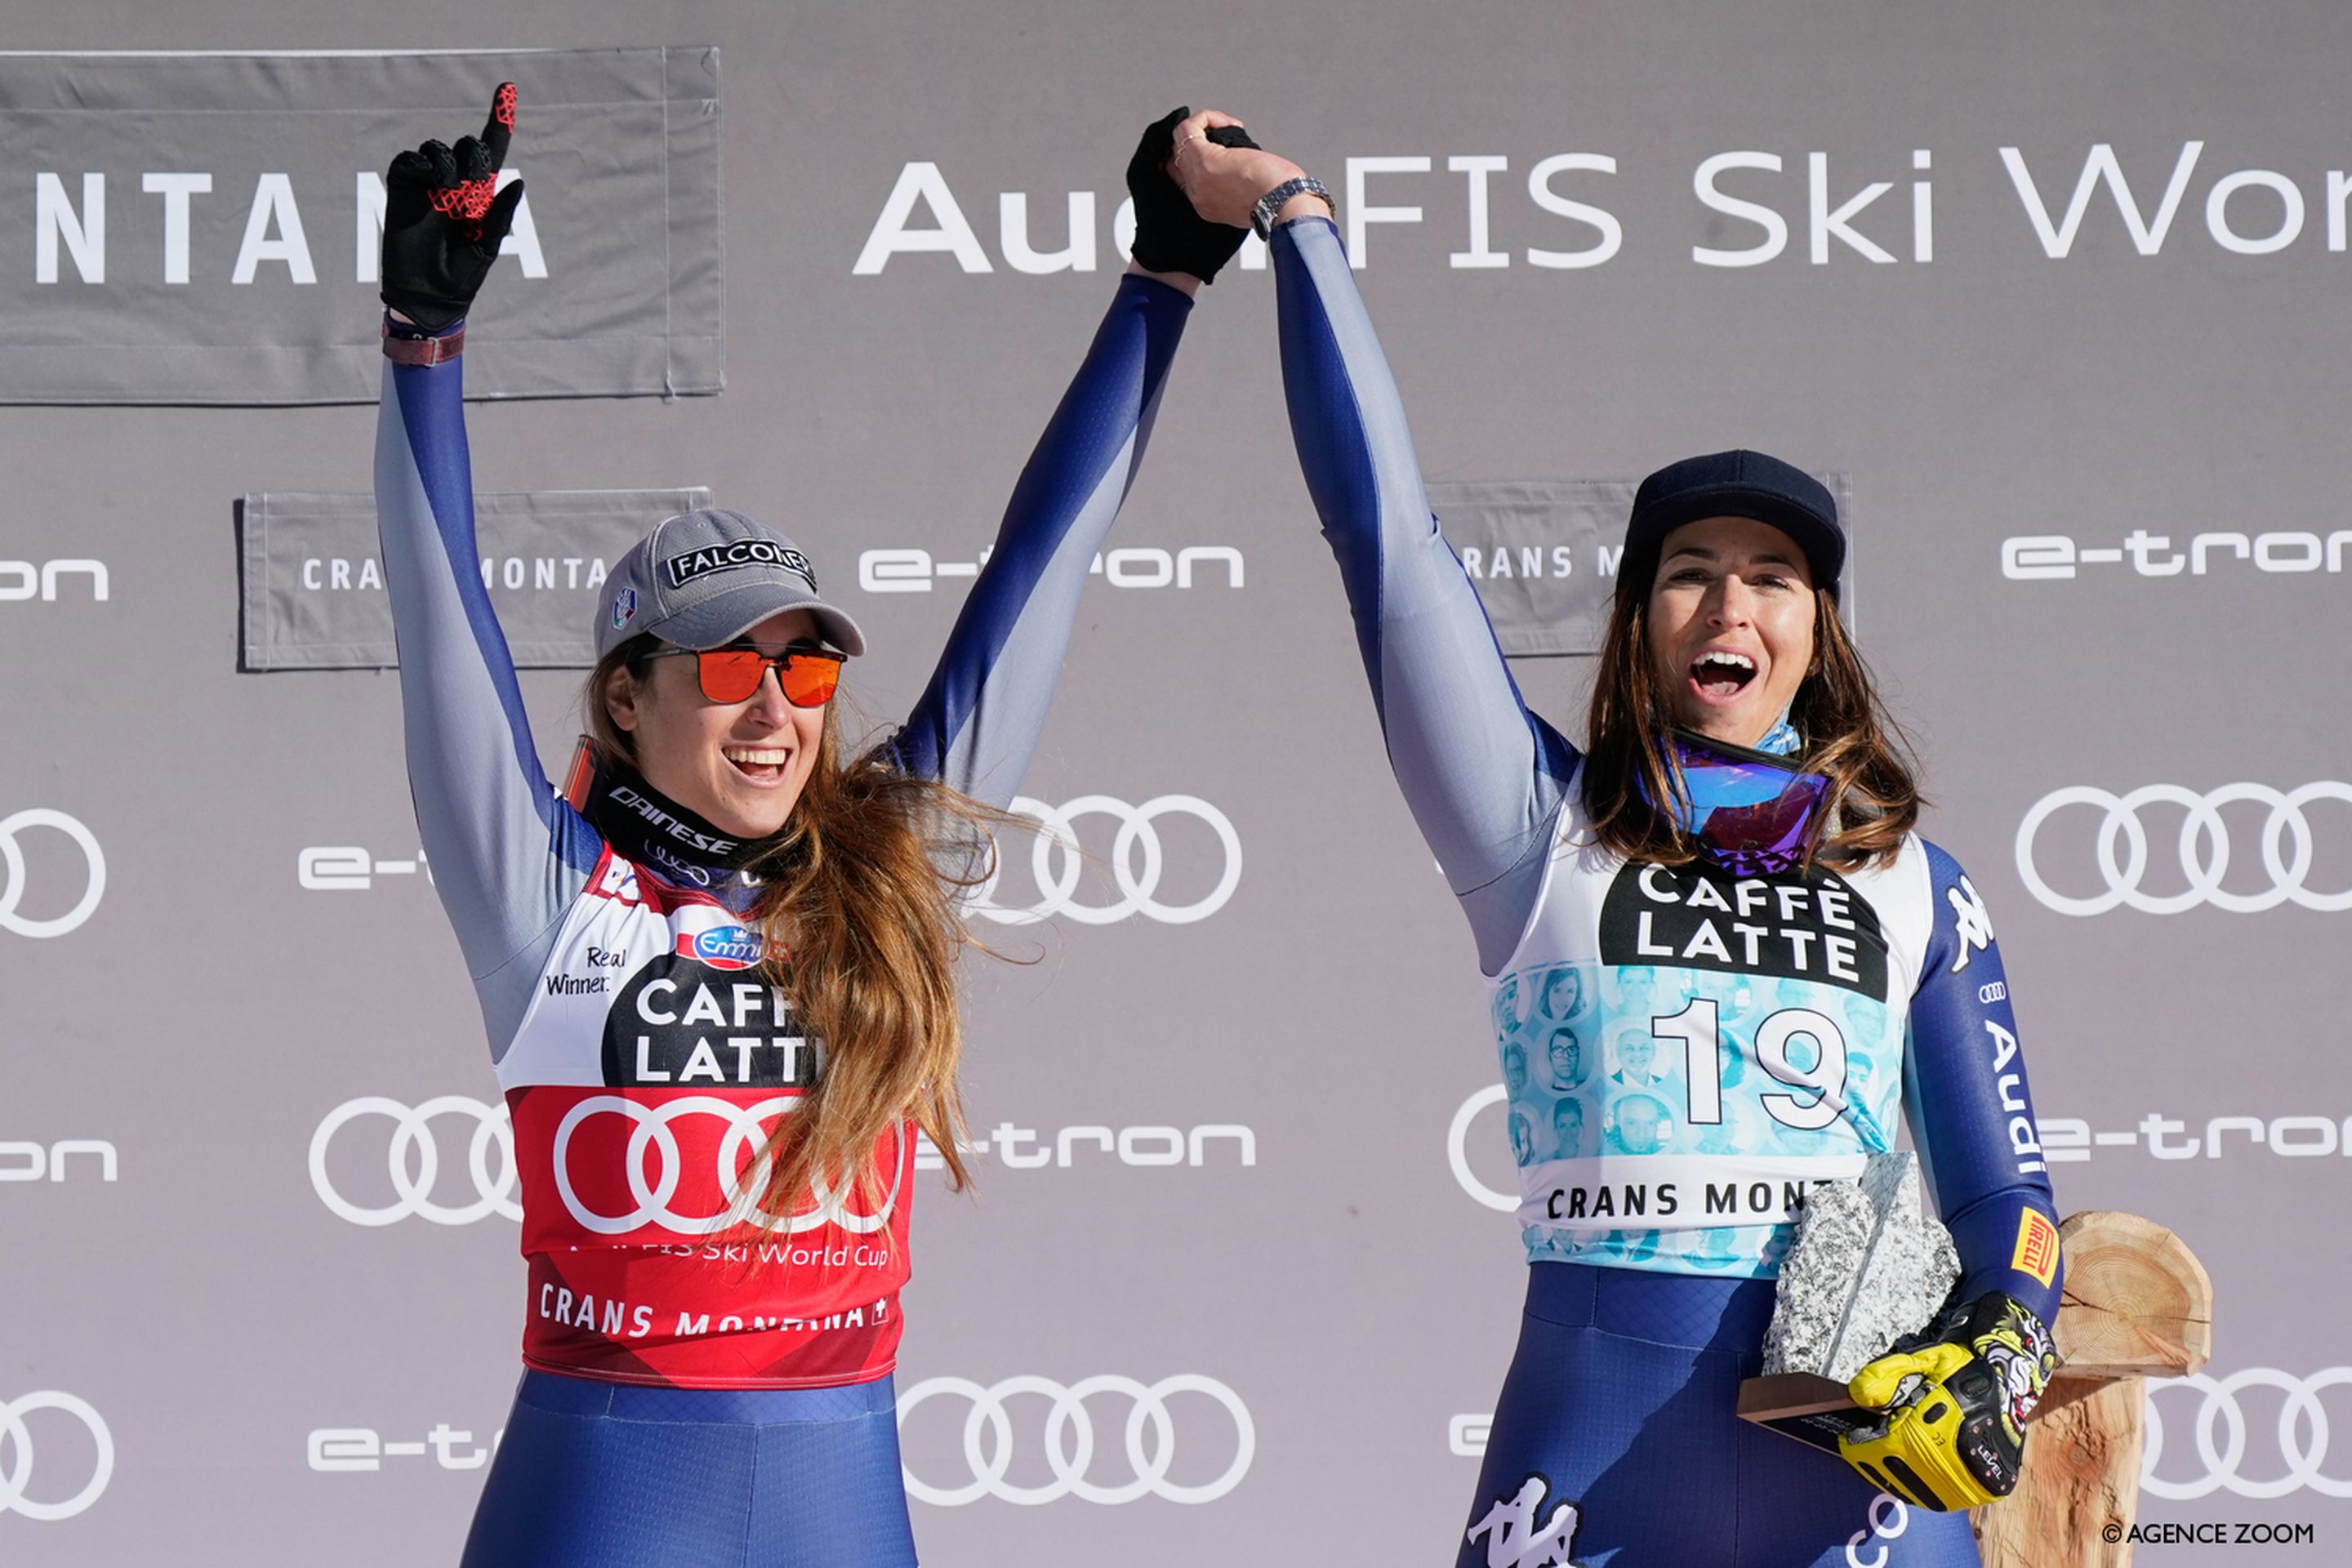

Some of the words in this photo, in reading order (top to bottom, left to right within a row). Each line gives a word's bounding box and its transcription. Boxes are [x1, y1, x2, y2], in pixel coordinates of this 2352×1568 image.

[1346, 153, 1624, 270] FIS
[1692, 149, 1934, 266] Ski
[859, 545, 1244, 592] e-on
[608, 786, 738, 855] DAINESE
[1638, 863, 1855, 930] CAFFÈ
[587, 947, 626, 968] Real
[1637, 911, 1860, 982] LATTE
[636, 979, 794, 1027] CAFF
[1651, 996, 1849, 1131] 19
[1984, 1019, 2047, 1174] Audi
[2034, 1113, 2352, 1161] e-tro
[1546, 1182, 1678, 1219] CRANS
[758, 1244, 848, 1266] World
[853, 1245, 889, 1271] Cup
[2022, 1215, 2055, 1277] PIRELLI
[540, 1283, 653, 1339] CRANS
